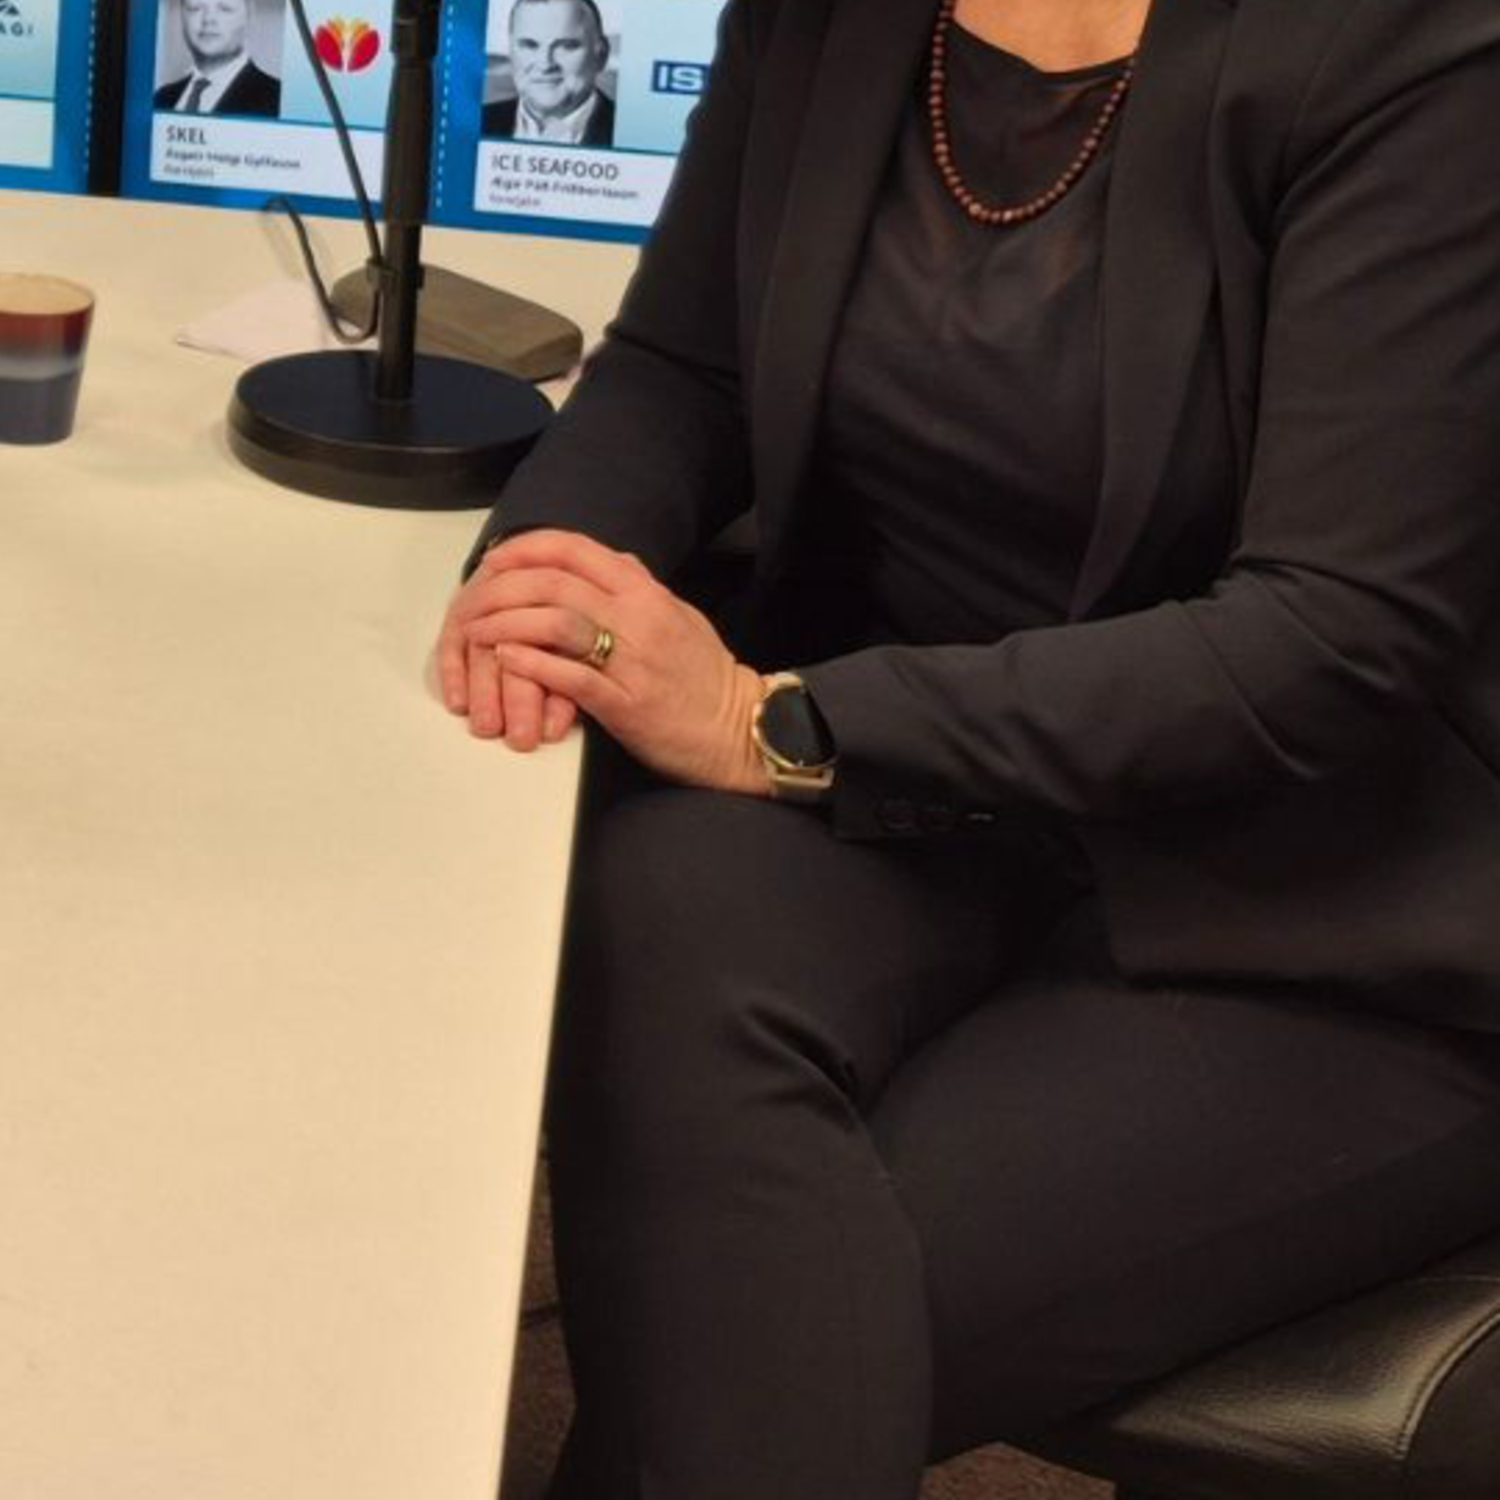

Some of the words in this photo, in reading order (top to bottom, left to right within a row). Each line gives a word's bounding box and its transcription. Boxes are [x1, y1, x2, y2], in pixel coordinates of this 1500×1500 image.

[165, 125, 208, 145] SKEL
[492, 154, 522, 173] ICE
[527, 156, 621, 181] SEAFOOD
